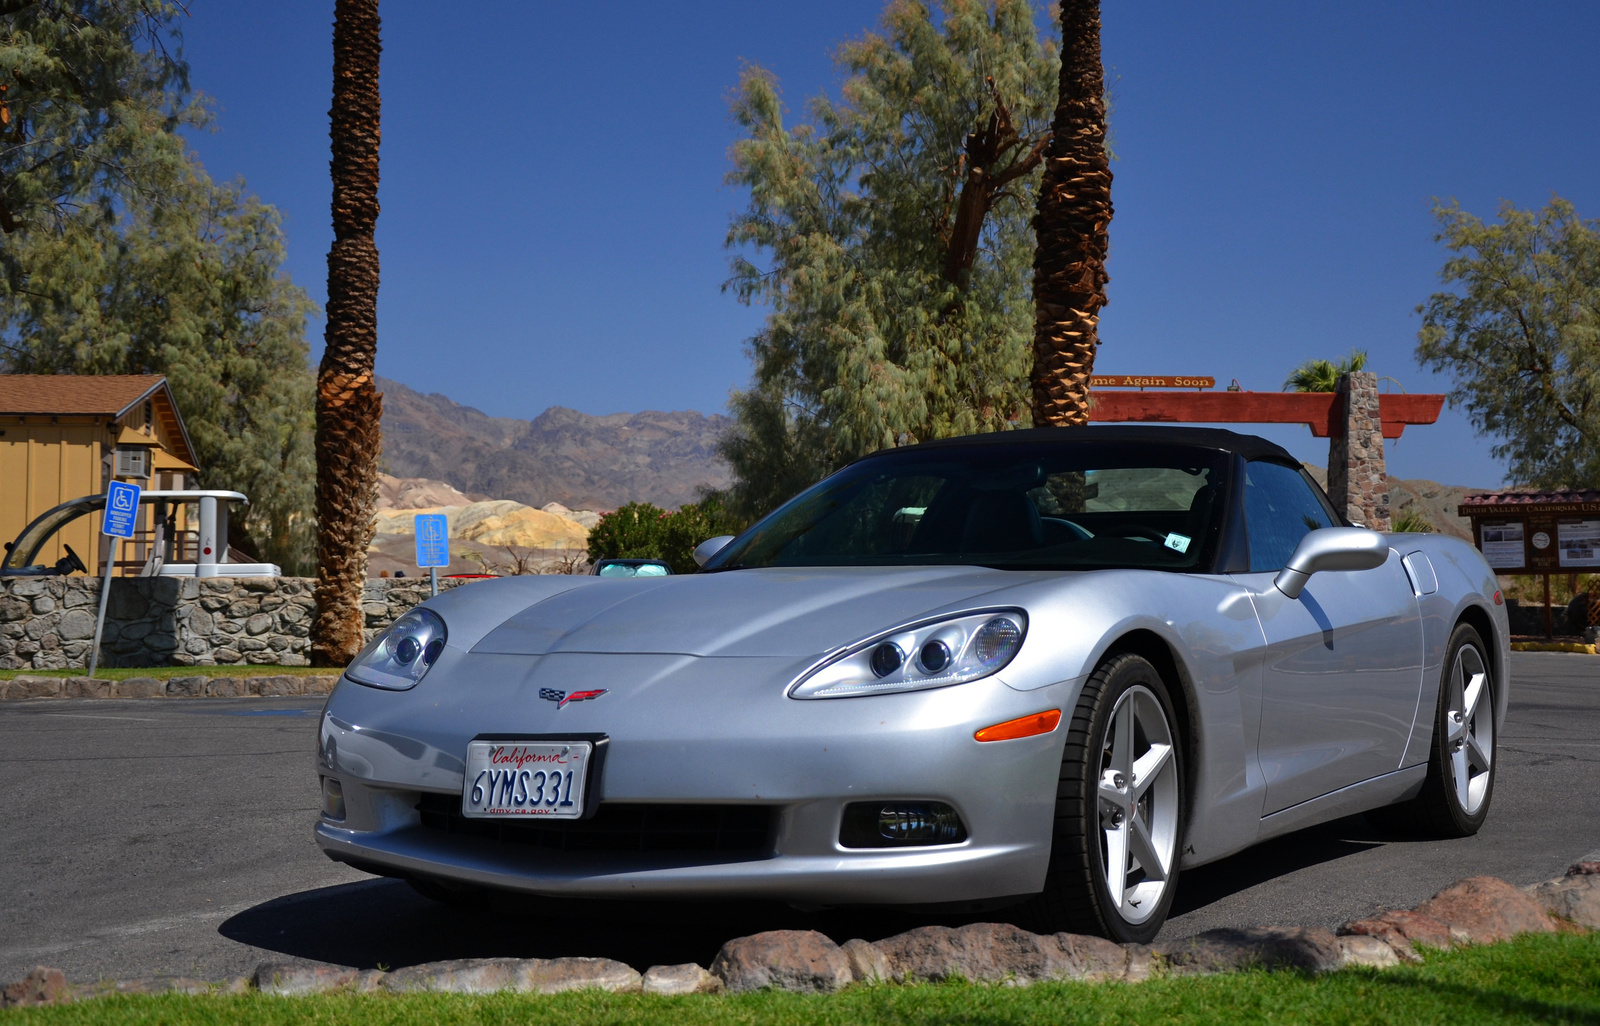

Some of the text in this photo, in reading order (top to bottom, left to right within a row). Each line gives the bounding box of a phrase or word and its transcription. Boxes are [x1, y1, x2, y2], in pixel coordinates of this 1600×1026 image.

[1122, 376, 1166, 386] Again
[1174, 376, 1210, 386] Soon
[1581, 503, 1600, 512] US
[492, 746, 568, 769] California
[471, 769, 574, 807] 6YMS331
[489, 807, 550, 815] dmv.ca.gov
